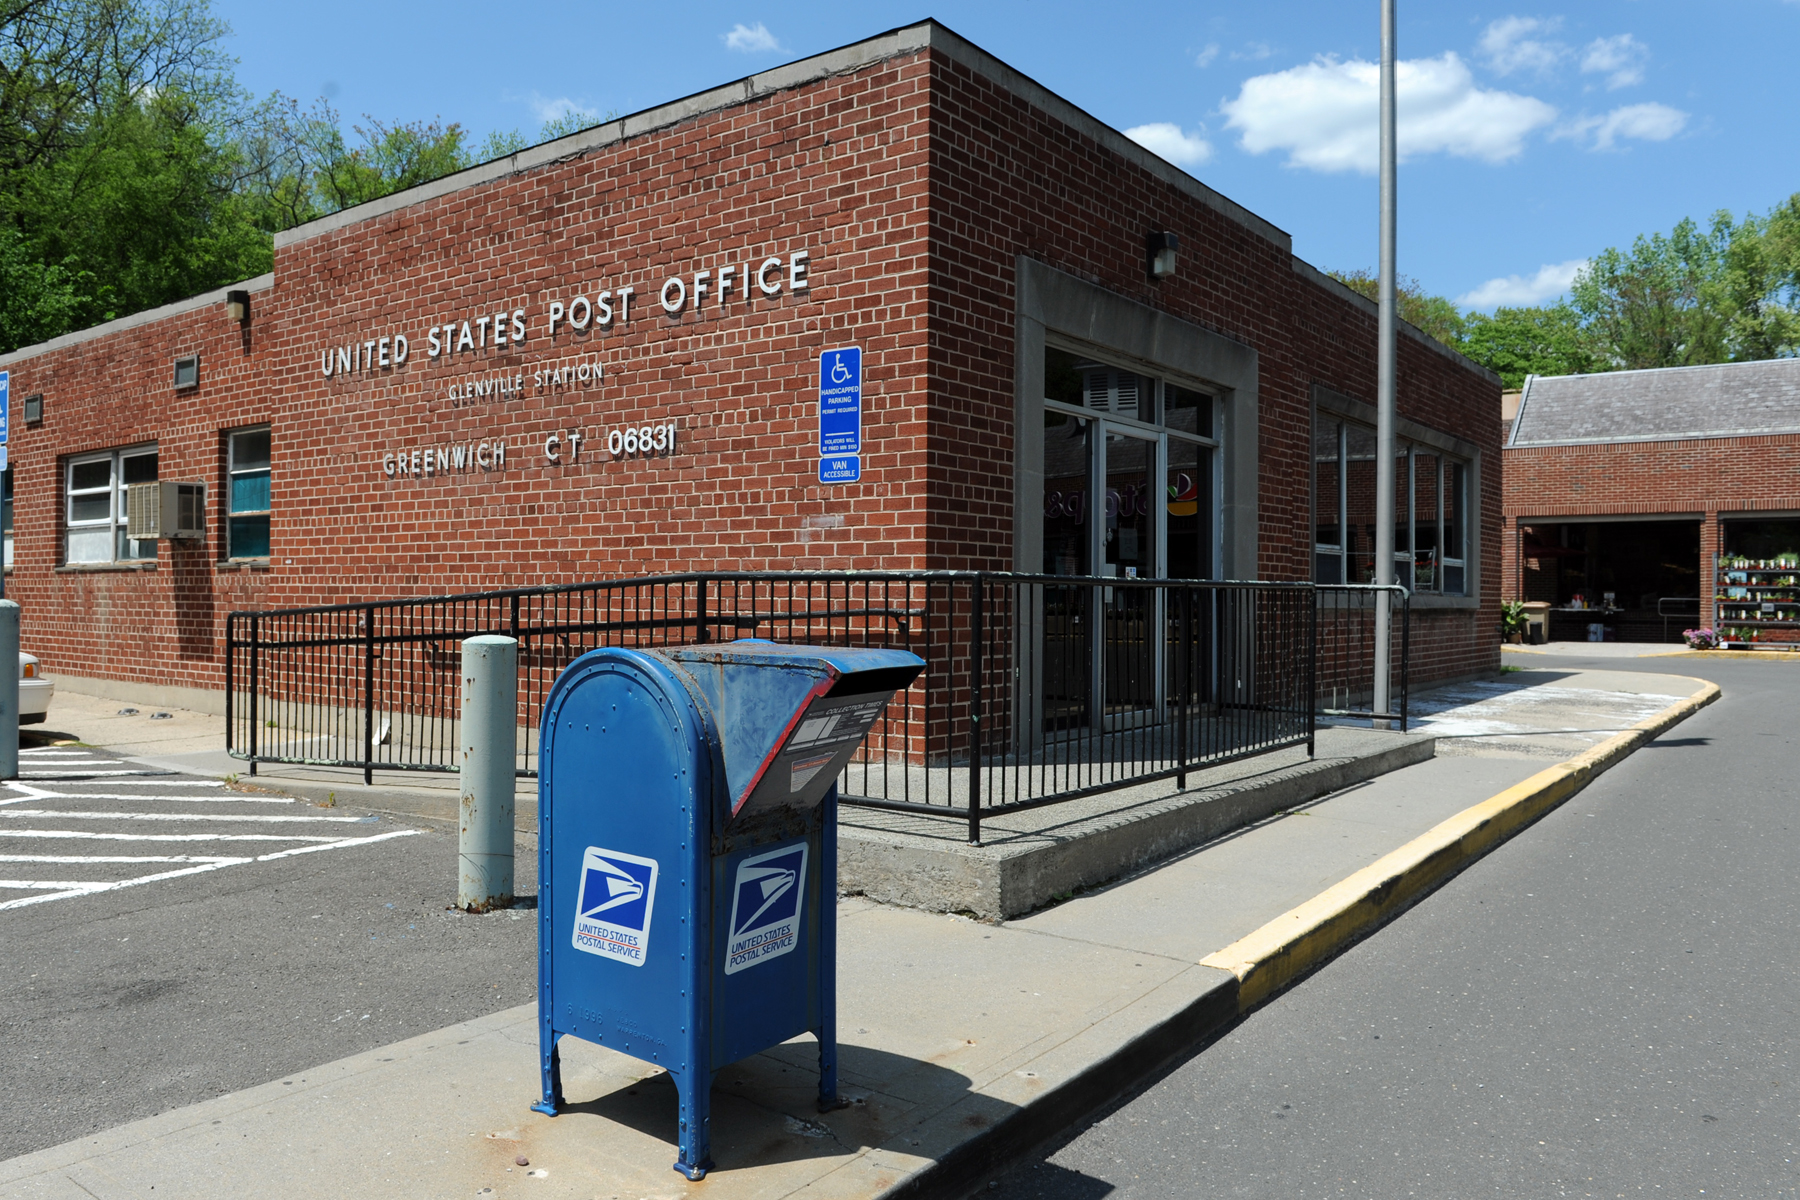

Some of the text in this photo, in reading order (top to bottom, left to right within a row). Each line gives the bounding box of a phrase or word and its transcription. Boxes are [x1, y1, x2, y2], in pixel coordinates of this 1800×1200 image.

[321, 250, 809, 377] UNITED STATES POST OFFICE
[448, 361, 604, 400] GLENVILLE STATION
[821, 386, 858, 395] HANDICAPPED
[828, 396, 851, 404] PARKING
[382, 423, 675, 476] GREENWICH CT 06831
[823, 470, 855, 478] ACCESSIBLE
[832, 460, 847, 470] VAN
[826, 704, 865, 715] COLLECTION
[578, 922, 638, 946] UNITED STATES
[731, 924, 791, 954] UNITED STATES
[576, 934, 641, 960] POSTAL SERVICE
[729, 936, 793, 968] POSTAL SERVICE
